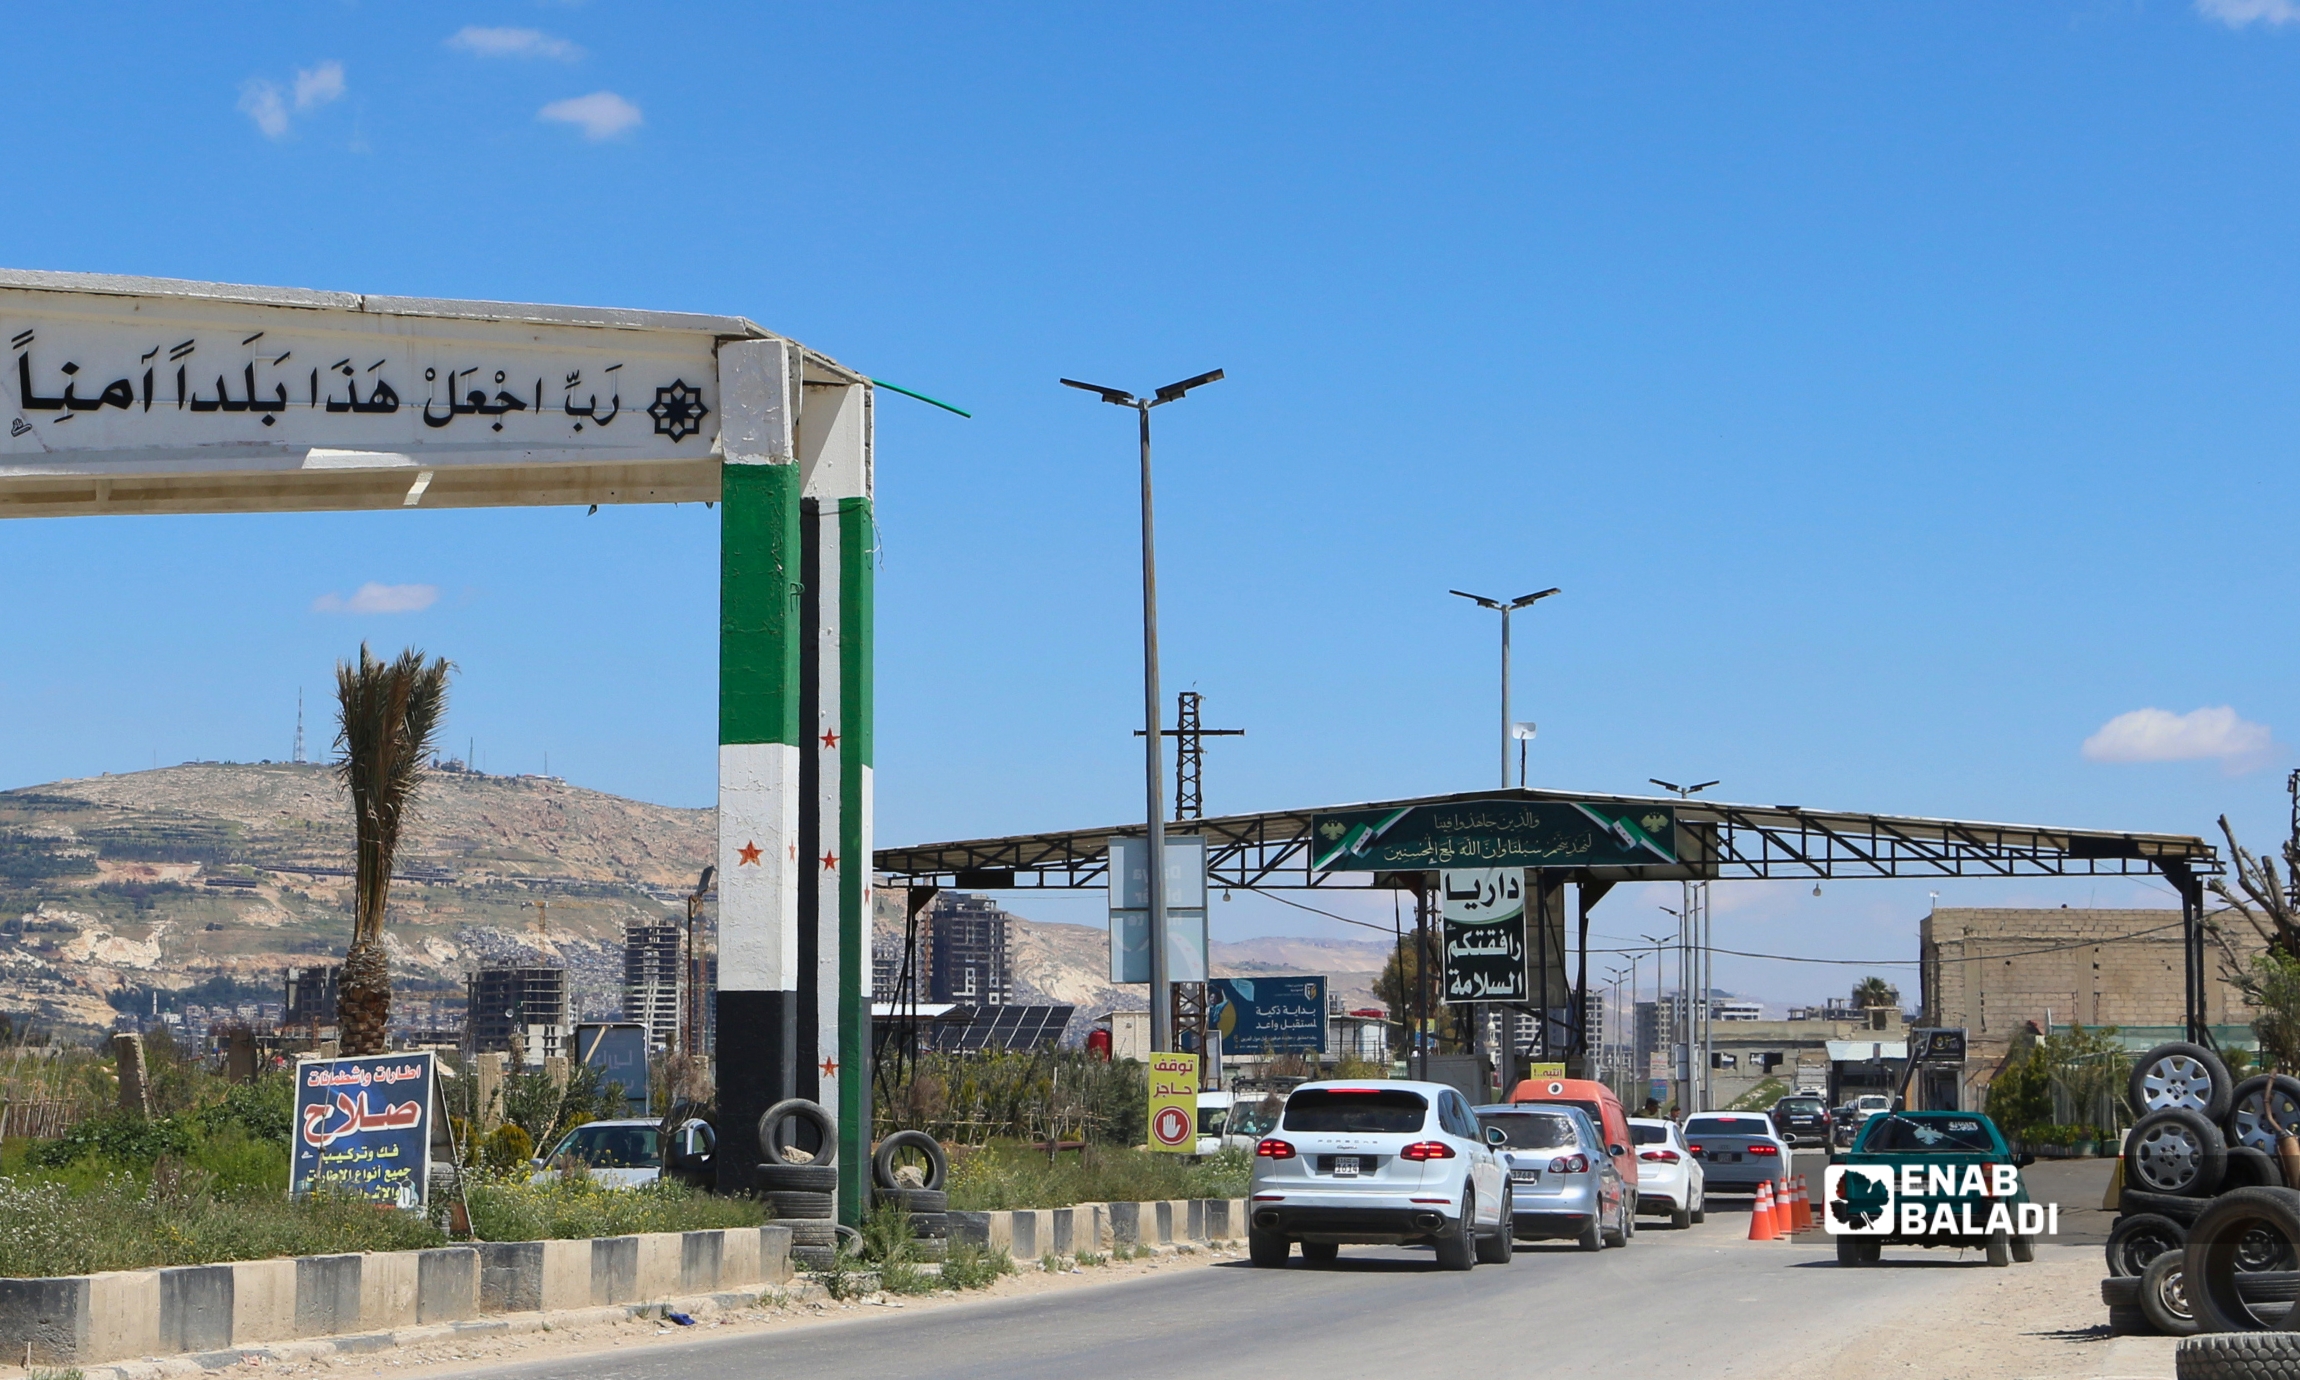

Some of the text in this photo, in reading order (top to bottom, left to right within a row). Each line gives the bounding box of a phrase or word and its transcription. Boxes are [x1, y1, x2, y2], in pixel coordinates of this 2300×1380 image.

[1445, 872, 1519, 910] داريا
[1447, 928, 1522, 964] رافقتكم
[1448, 968, 1523, 998] السلامة
[1255, 1005, 1316, 1018] بداية ذكية
[1255, 1019, 1279, 1031] واعد
[373, 1064, 421, 1084] اطارات
[1154, 1058, 1193, 1076] توقف
[1153, 1082, 1193, 1098] حاجز
[304, 1090, 422, 1148] صلاح
[321, 1143, 399, 1164] فك وتركيب
[383, 1166, 412, 1182] جميع
